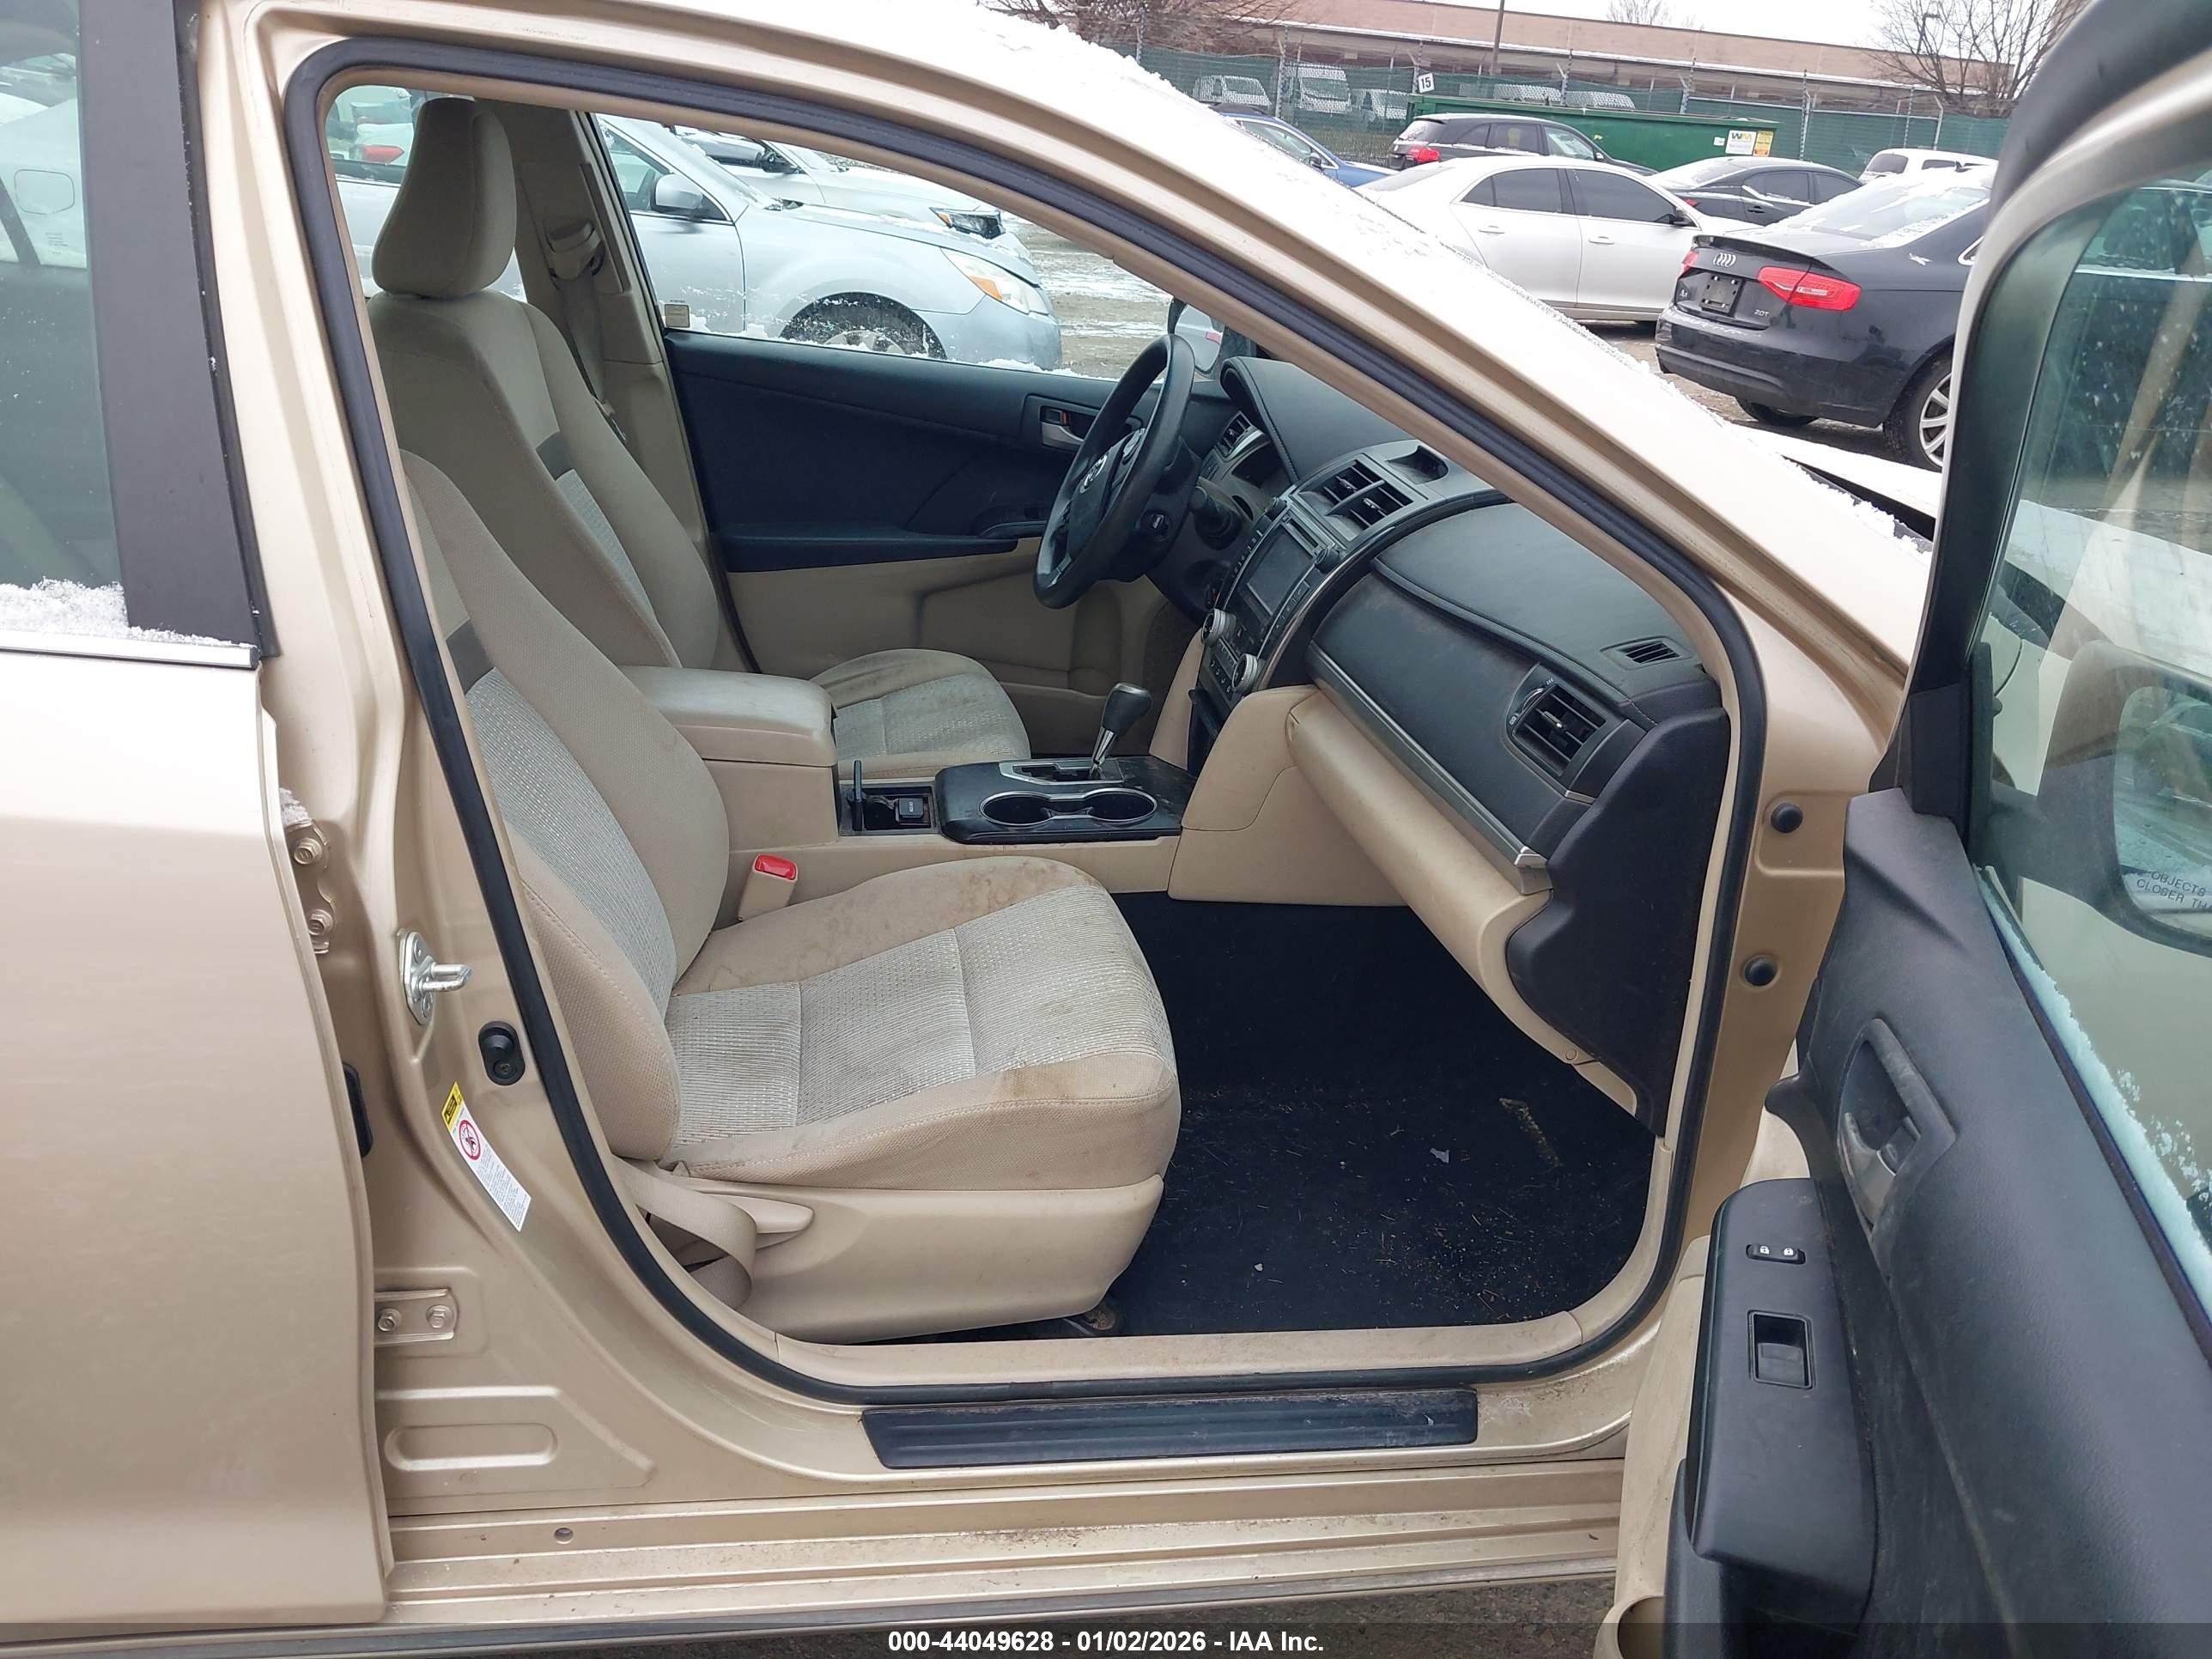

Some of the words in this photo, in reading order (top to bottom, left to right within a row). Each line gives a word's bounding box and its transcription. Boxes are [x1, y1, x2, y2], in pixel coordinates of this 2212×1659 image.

[1420, 76, 1431, 88] 15
[2136, 878, 2185, 903] CLOSER
[2151, 871, 2207, 897] OBJECTS
